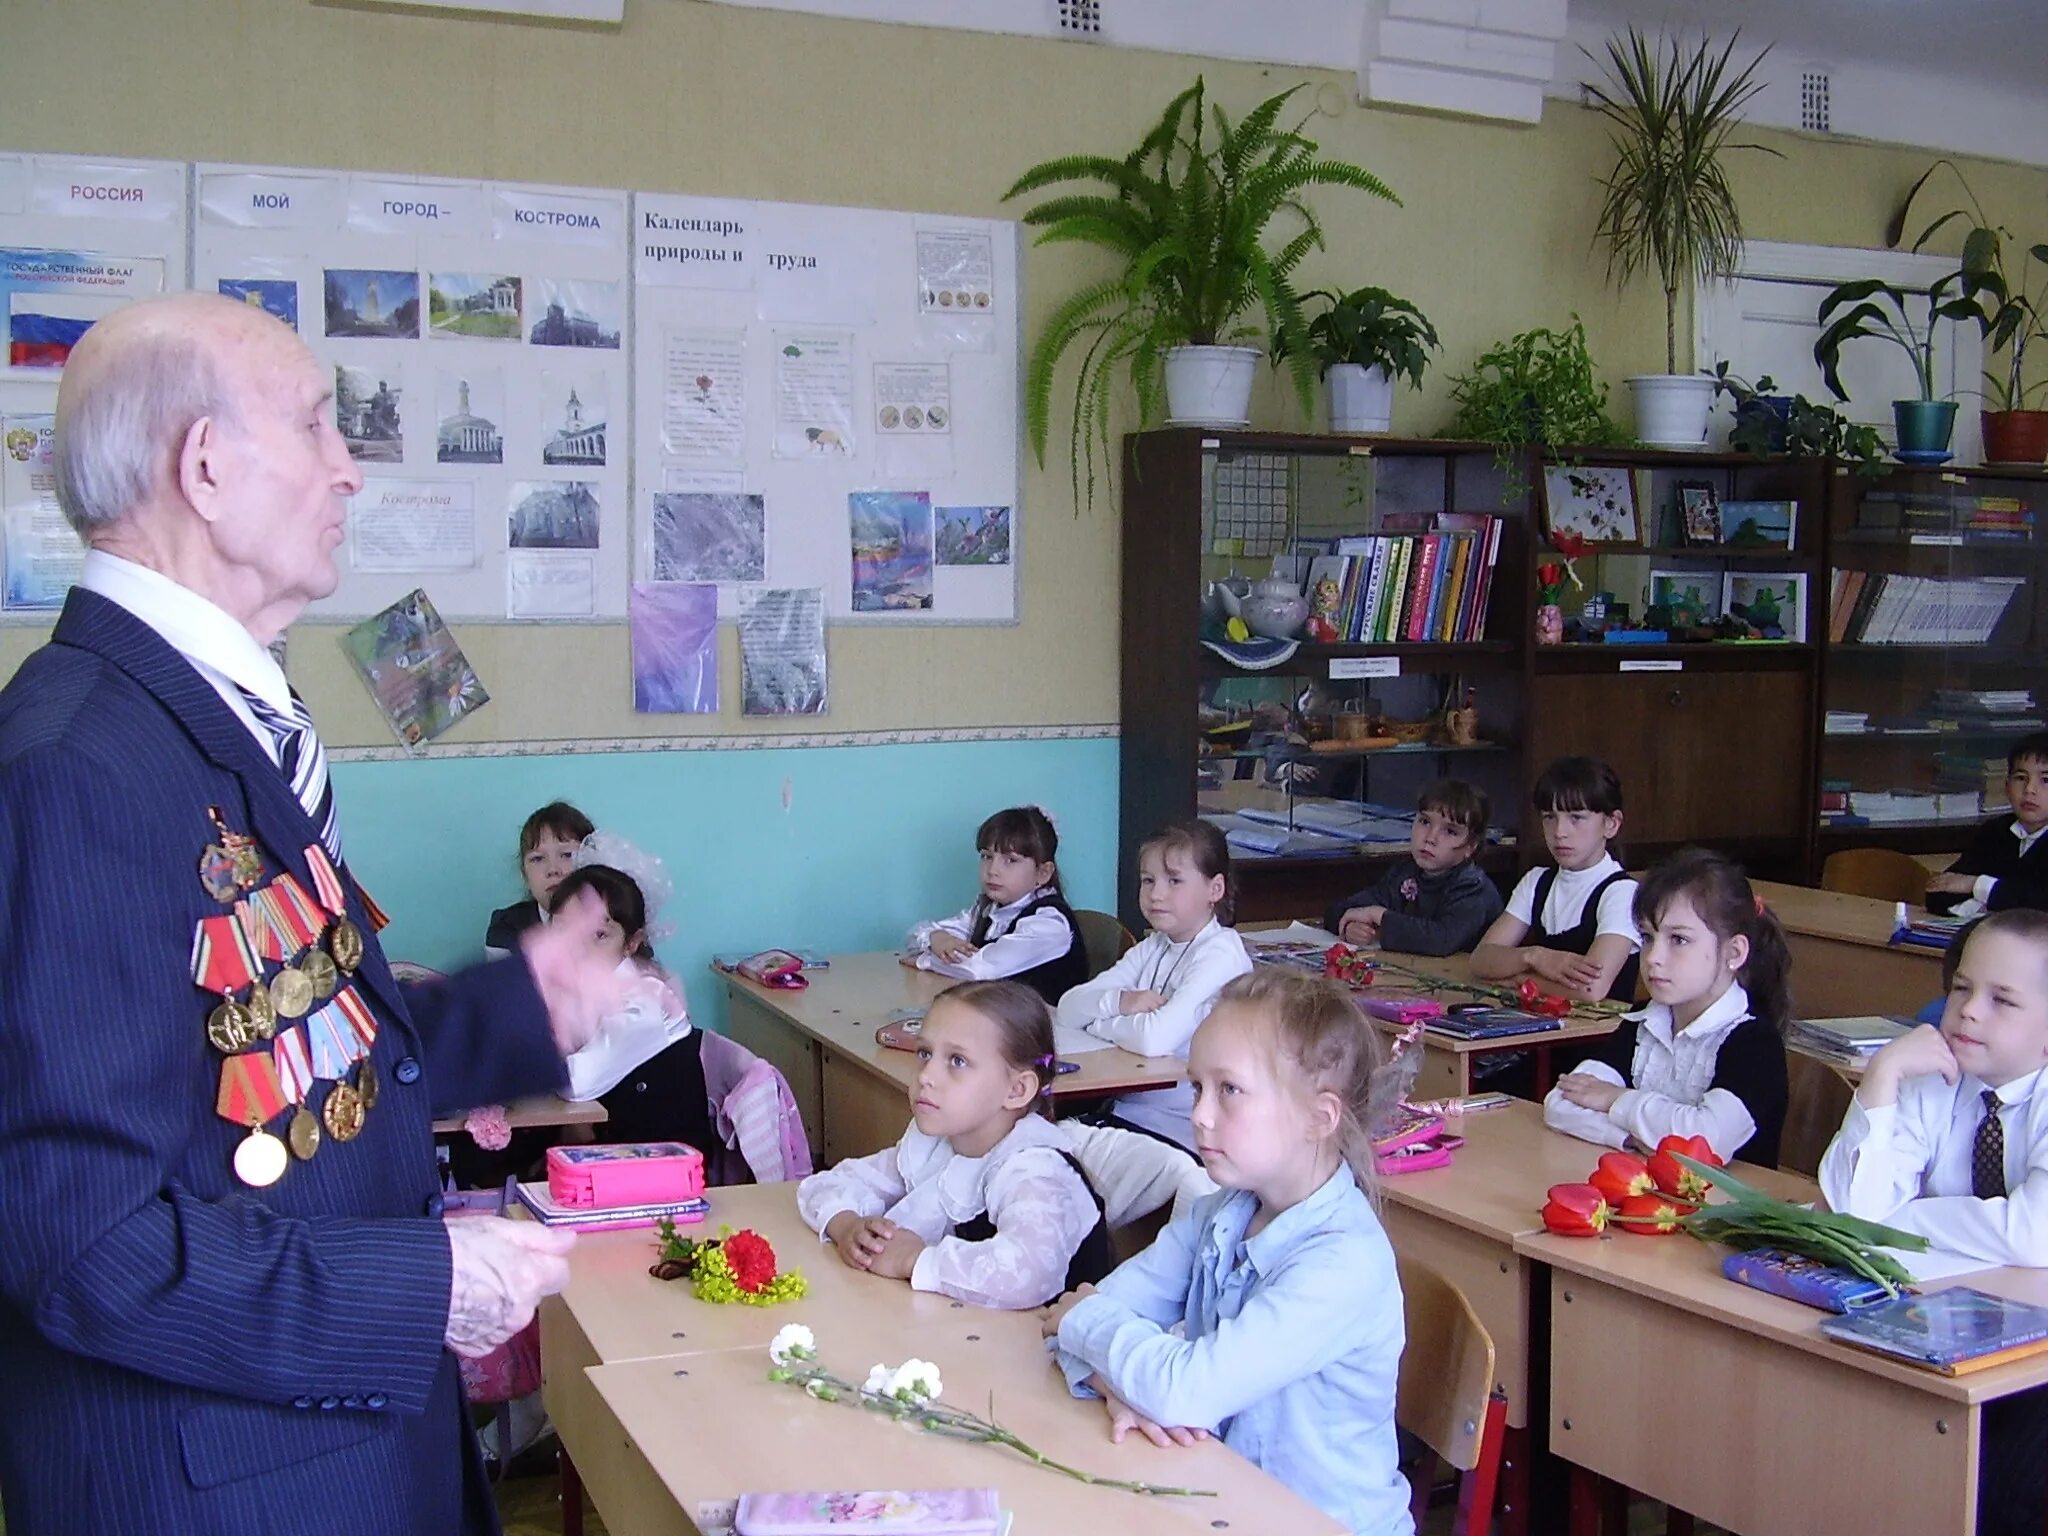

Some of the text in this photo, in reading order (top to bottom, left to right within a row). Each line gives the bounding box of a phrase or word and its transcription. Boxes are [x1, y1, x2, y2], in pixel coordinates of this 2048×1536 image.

[71, 185, 144, 202] РОССИЯ
[252, 192, 290, 209] МОЙ
[514, 209, 601, 229] КОСТРОМА
[645, 212, 744, 237] Календарь
[7, 261, 134, 277] ГОСУДАРСТВЕННЫЙ ФЛАГ
[645, 245, 817, 271] природы и труда
[1363, 545, 1384, 635] РУССКИЕ СКАЗКИ
